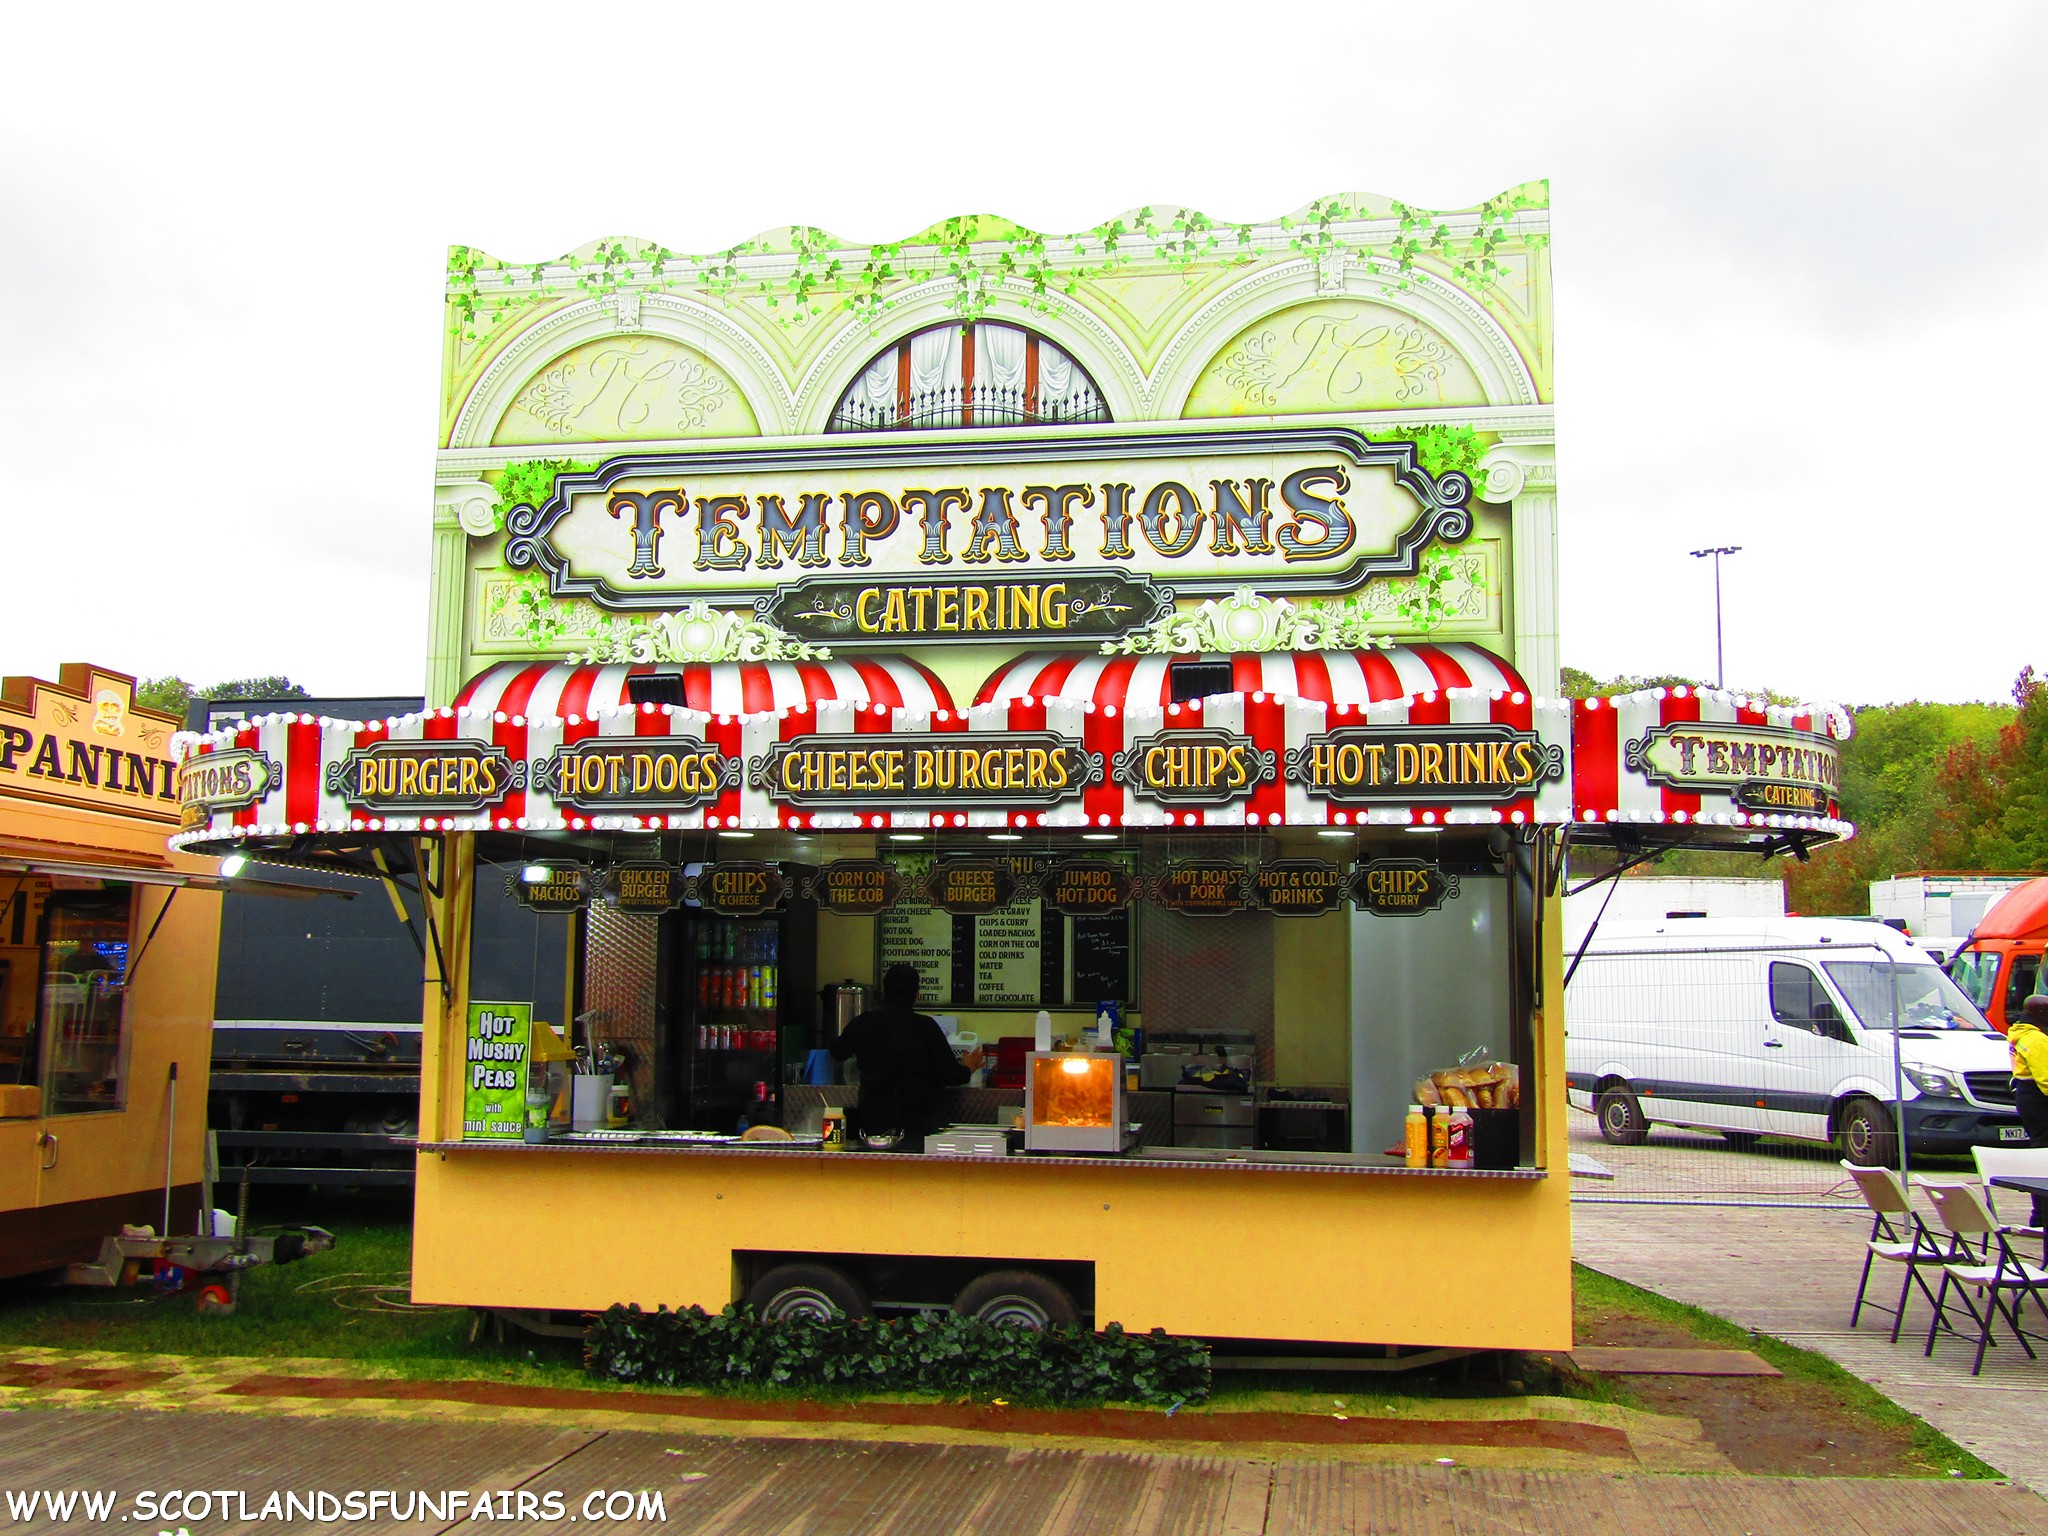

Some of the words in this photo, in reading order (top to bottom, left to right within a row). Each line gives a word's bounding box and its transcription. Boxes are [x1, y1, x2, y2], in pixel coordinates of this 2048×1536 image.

[606, 464, 1356, 579] TEMPTATIONS
[856, 581, 1069, 634] CATERING
[782, 749, 905, 792] CHEESE
[912, 747, 1068, 791] BURGERS
[1144, 745, 1248, 788] CHIPS
[1308, 743, 1386, 786] HOT
[1394, 740, 1537, 786] DRINKS
[357, 754, 498, 797] BURGERS
[559, 753, 625, 795] HOT
[631, 751, 719, 795] DOGS
[1764, 784, 1816, 807] CATERING
[619, 870, 670, 885] CHICKEN
[712, 871, 767, 895] CHIPS
[827, 870, 863, 886] CORN
[865, 870, 886, 885] ON
[948, 870, 995, 886] CHEESE
[1061, 870, 1112, 886] JUMBO
[1172, 870, 1199, 885] HOT
[1202, 870, 1244, 885] ROAST
[1259, 871, 1288, 887] HOT
[1290, 871, 1300, 886] &
[1302, 871, 1339, 886] COLD
[1366, 870, 1428, 894] CHIPS
[529, 886, 581, 901] NACHOS
[620, 884, 668, 898] BURGER
[830, 888, 856, 903] THE
[857, 888, 884, 903] COB
[947, 886, 997, 902] BURGER
[1056, 888, 1085, 904] HOT
[1086, 888, 1117, 904] DOG
[1189, 885, 1226, 900] PORK
[1271, 888, 1324, 904] DRINKS
[719, 895, 727, 906] &
[727, 895, 761, 906] CHEESE
[1377, 894, 1387, 906] &
[1387, 894, 1420, 907] CURRY
[1006, 918, 1029, 926] CURRY
[883, 927, 897, 935] HOT
[898, 927, 913, 935] DOG
[979, 929, 1007, 937] LOADED
[1008, 929, 1036, 937] NACHOS
[882, 949, 920, 957] FOOTLONG
[920, 949, 935, 957] HOT
[936, 949, 951, 957] DOG
[998, 951, 1025, 959] DRINKS
[912, 960, 939, 968] BURGER
[979, 962, 1004, 970] WATER
[921, 977, 940, 985] PORK
[978, 994, 994, 1002] HOT
[994, 994, 1035, 1002] CHOCOLATE
[479, 1010, 516, 1041] HOT
[466, 1037, 526, 1062] MUSHY
[472, 1063, 517, 1091] PEAS
[484, 1102, 503, 1114] with
[490, 1120, 522, 1133] sauce
[2005, 1128, 2022, 1139] NK17
